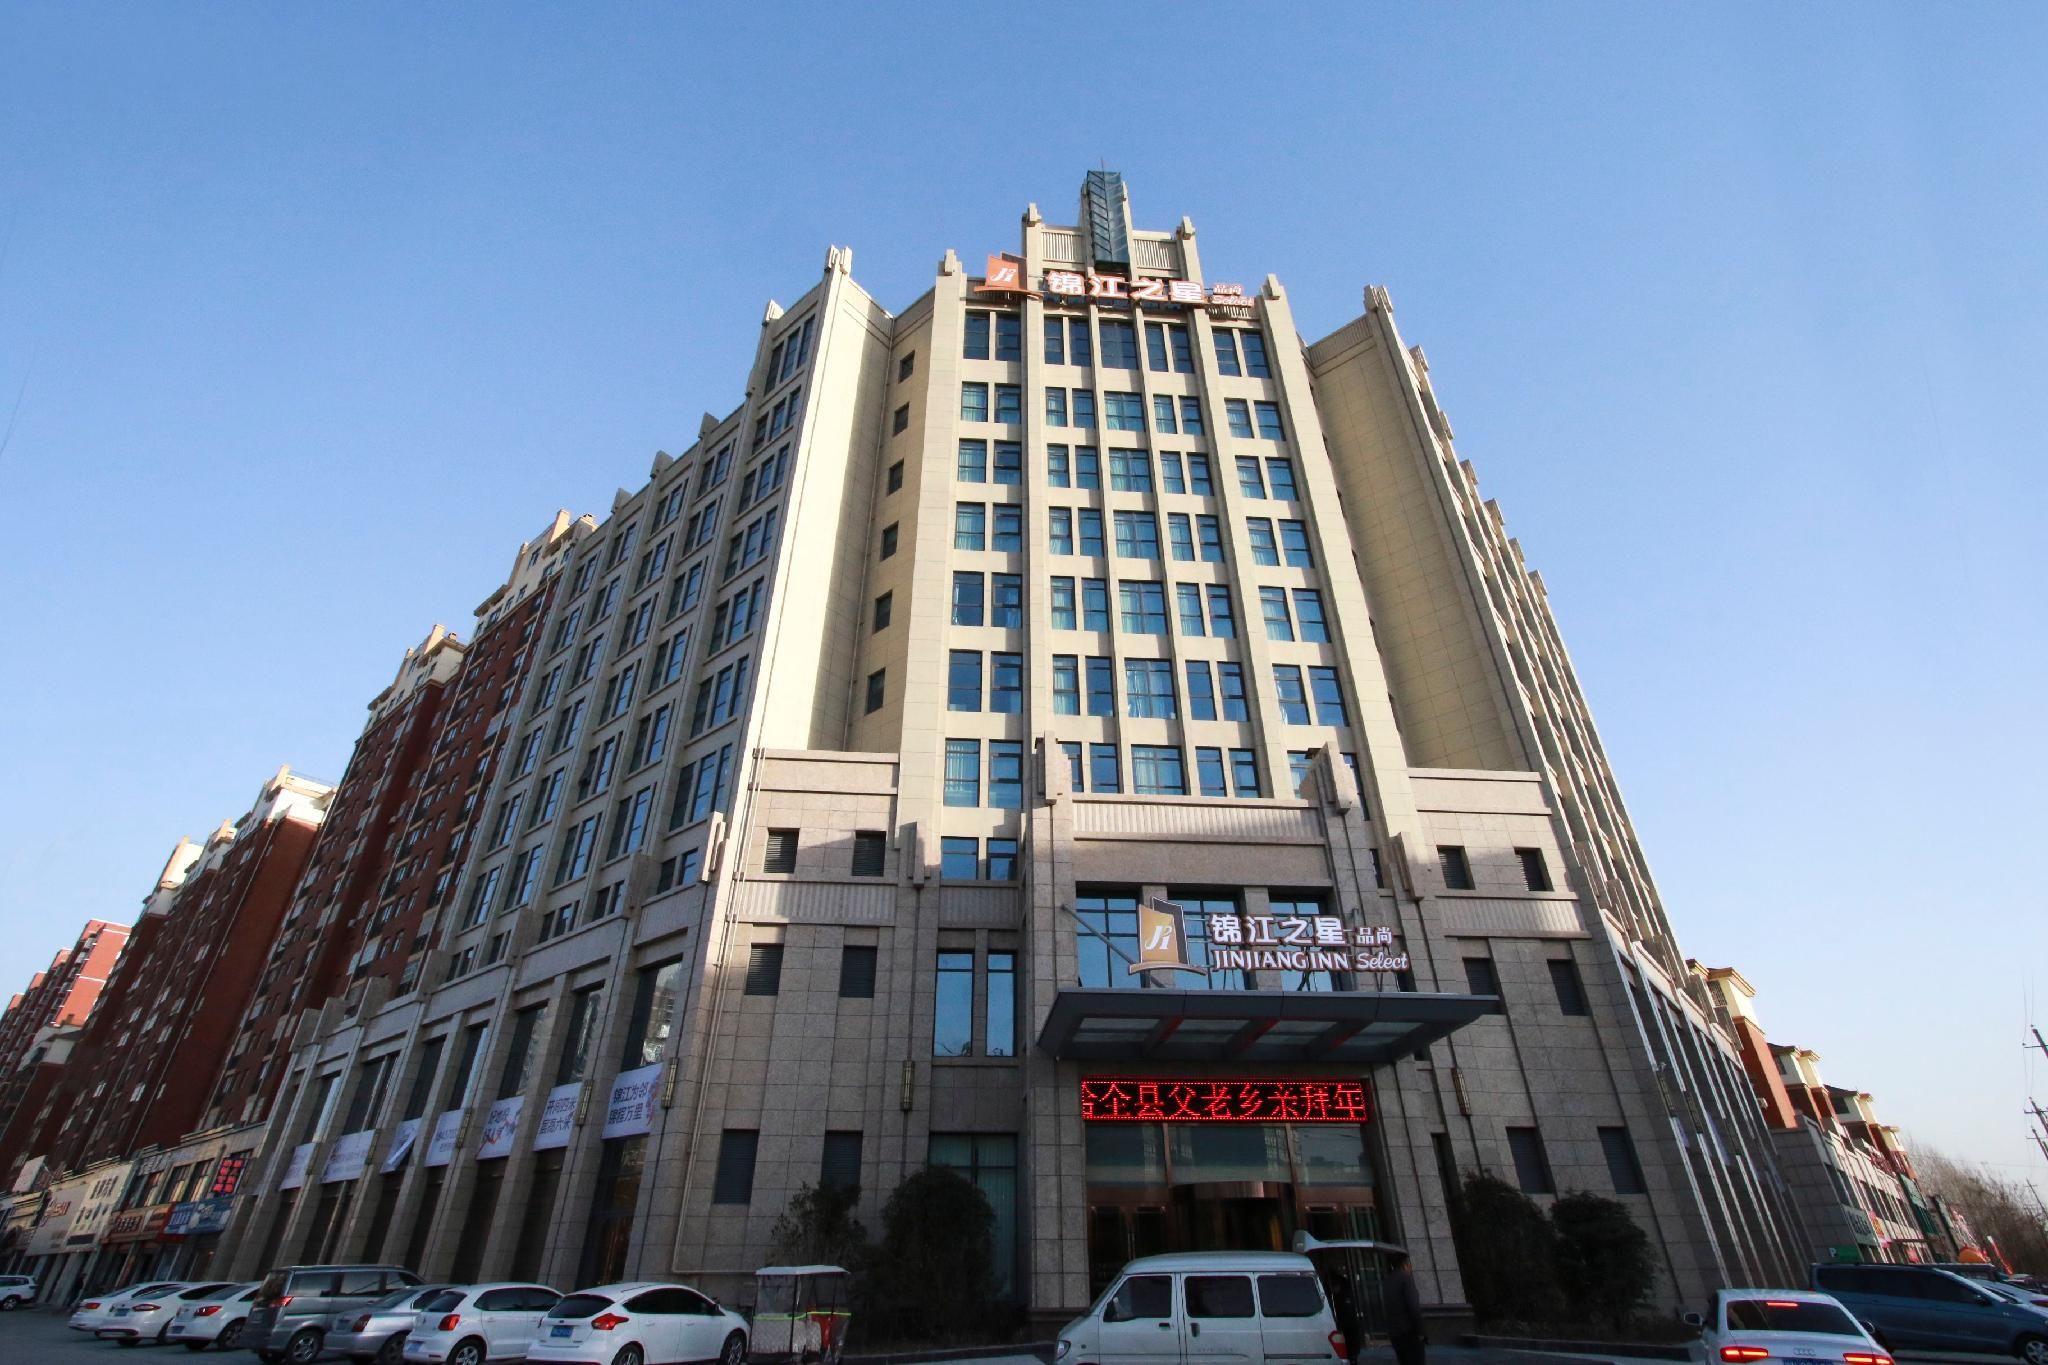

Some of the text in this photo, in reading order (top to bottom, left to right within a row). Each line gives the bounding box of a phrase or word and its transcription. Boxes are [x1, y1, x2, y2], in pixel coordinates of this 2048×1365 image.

[1048, 271, 1205, 303] 锦江之星
[1211, 914, 1346, 945] 锦江之星
[1356, 926, 1393, 945] 品尚
[1356, 951, 1409, 970] Select
